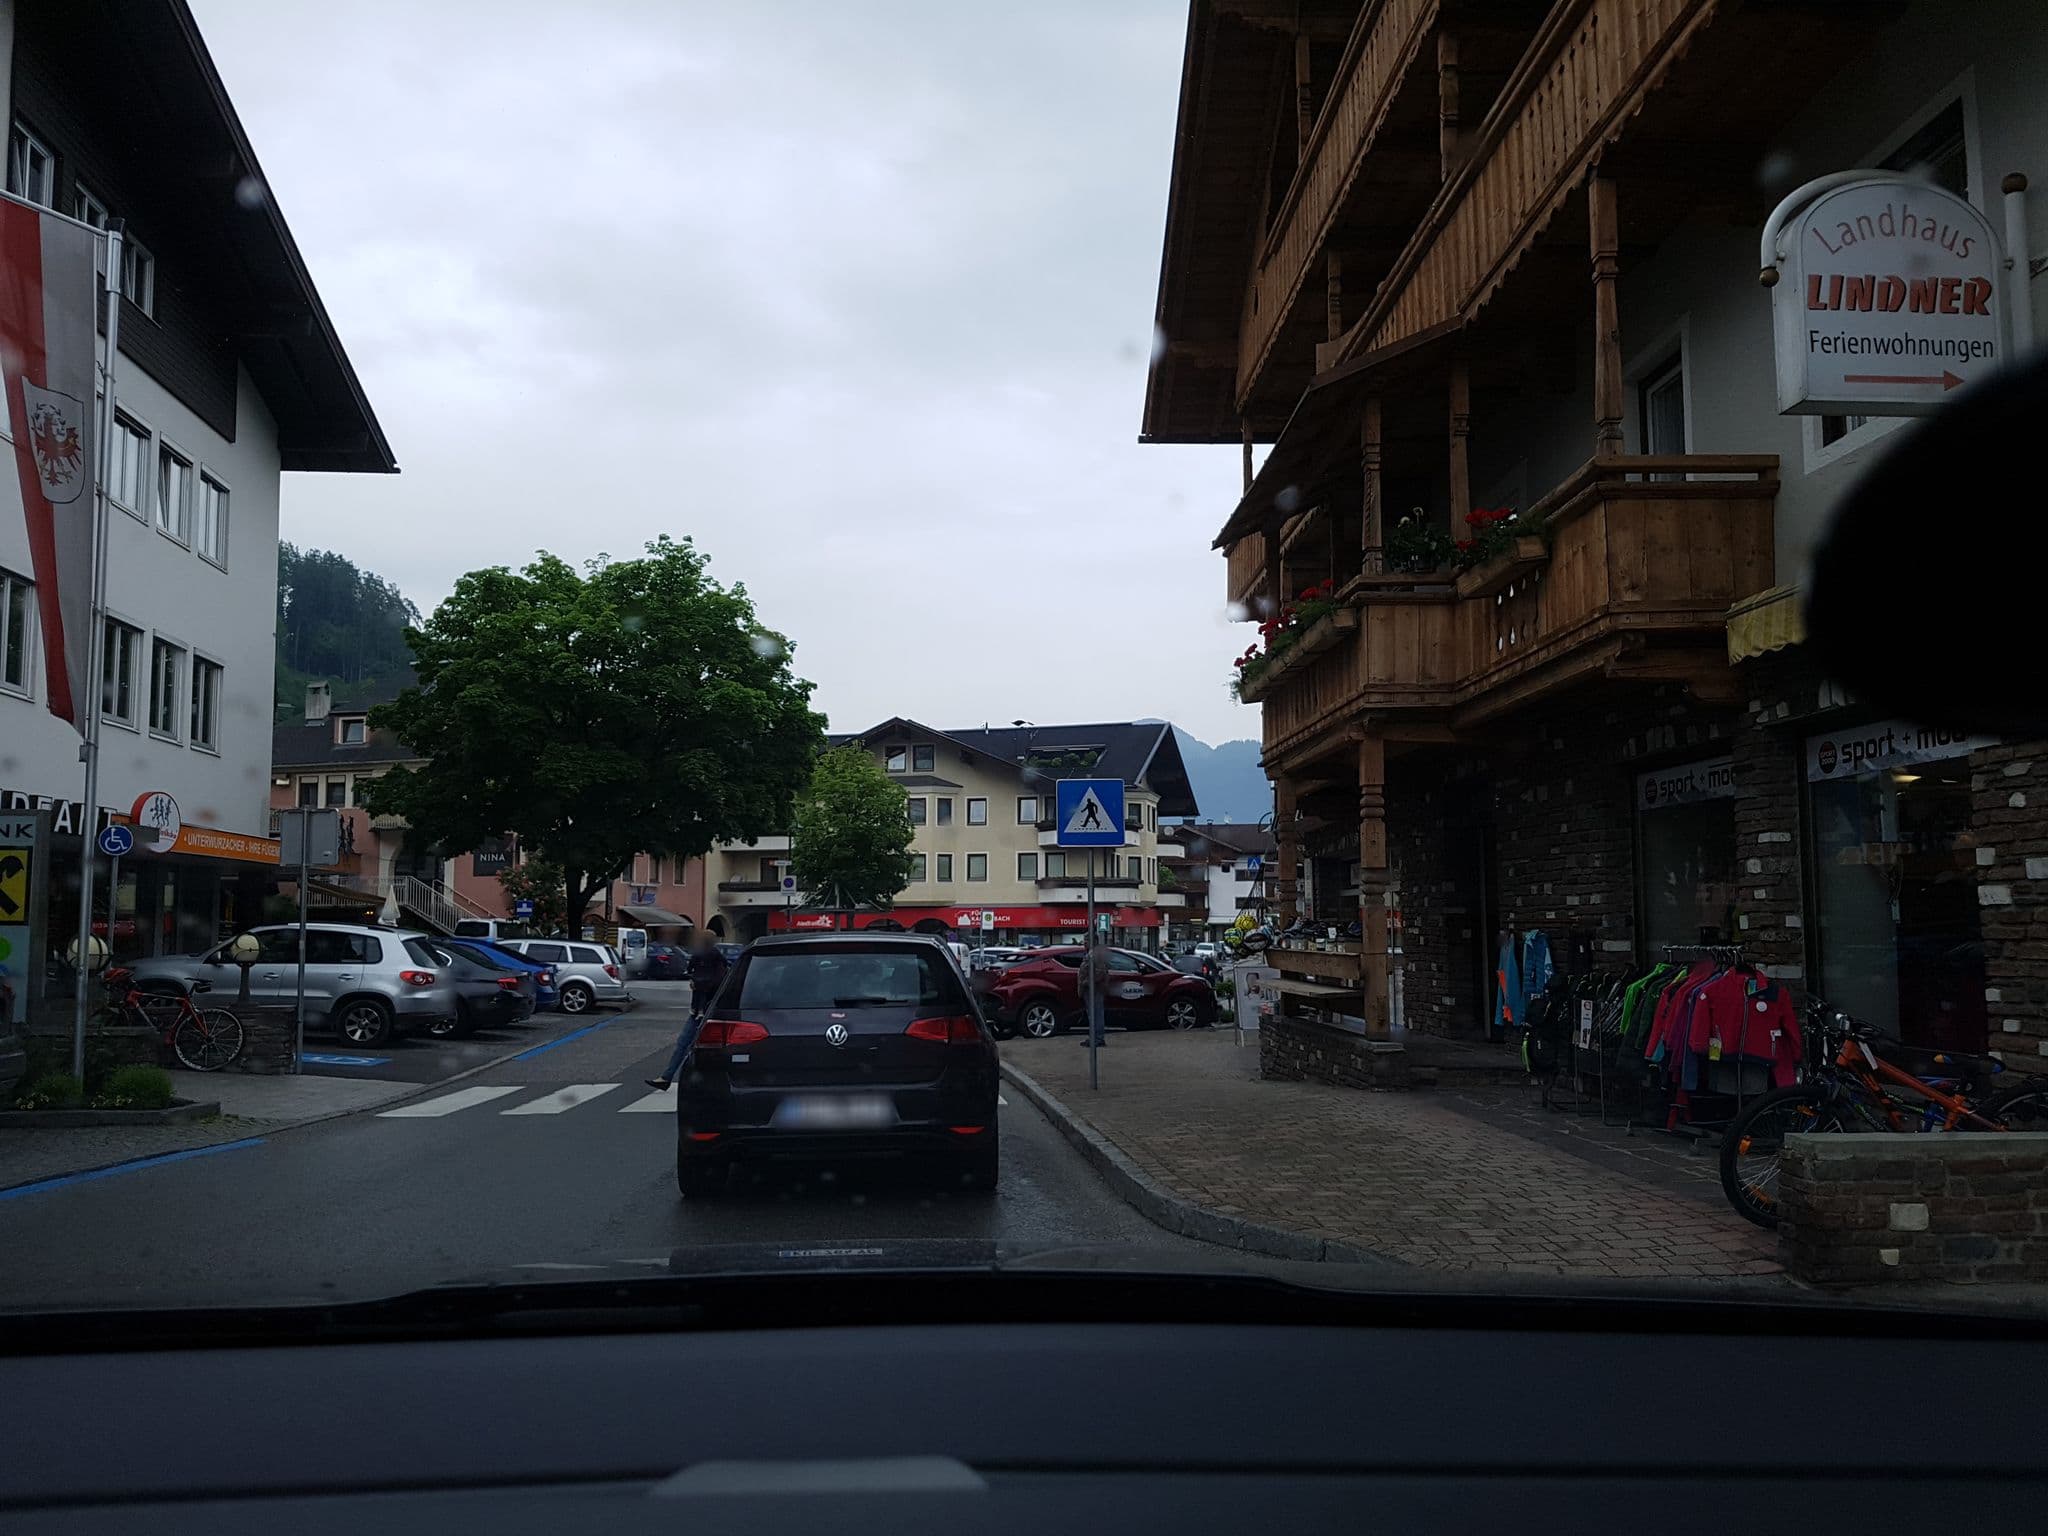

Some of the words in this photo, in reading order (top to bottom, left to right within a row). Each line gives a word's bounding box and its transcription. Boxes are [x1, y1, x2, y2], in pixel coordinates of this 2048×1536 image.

[1812, 203, 1976, 259] Landhaus
[1807, 274, 1993, 316] LINDNER
[1809, 330, 1994, 362] Ferienwohnungen
[1841, 728, 1896, 770] sport
[1660, 768, 1697, 798] sport
[480, 853, 505, 862] NINA
[1060, 918, 1086, 926] TOURIST
